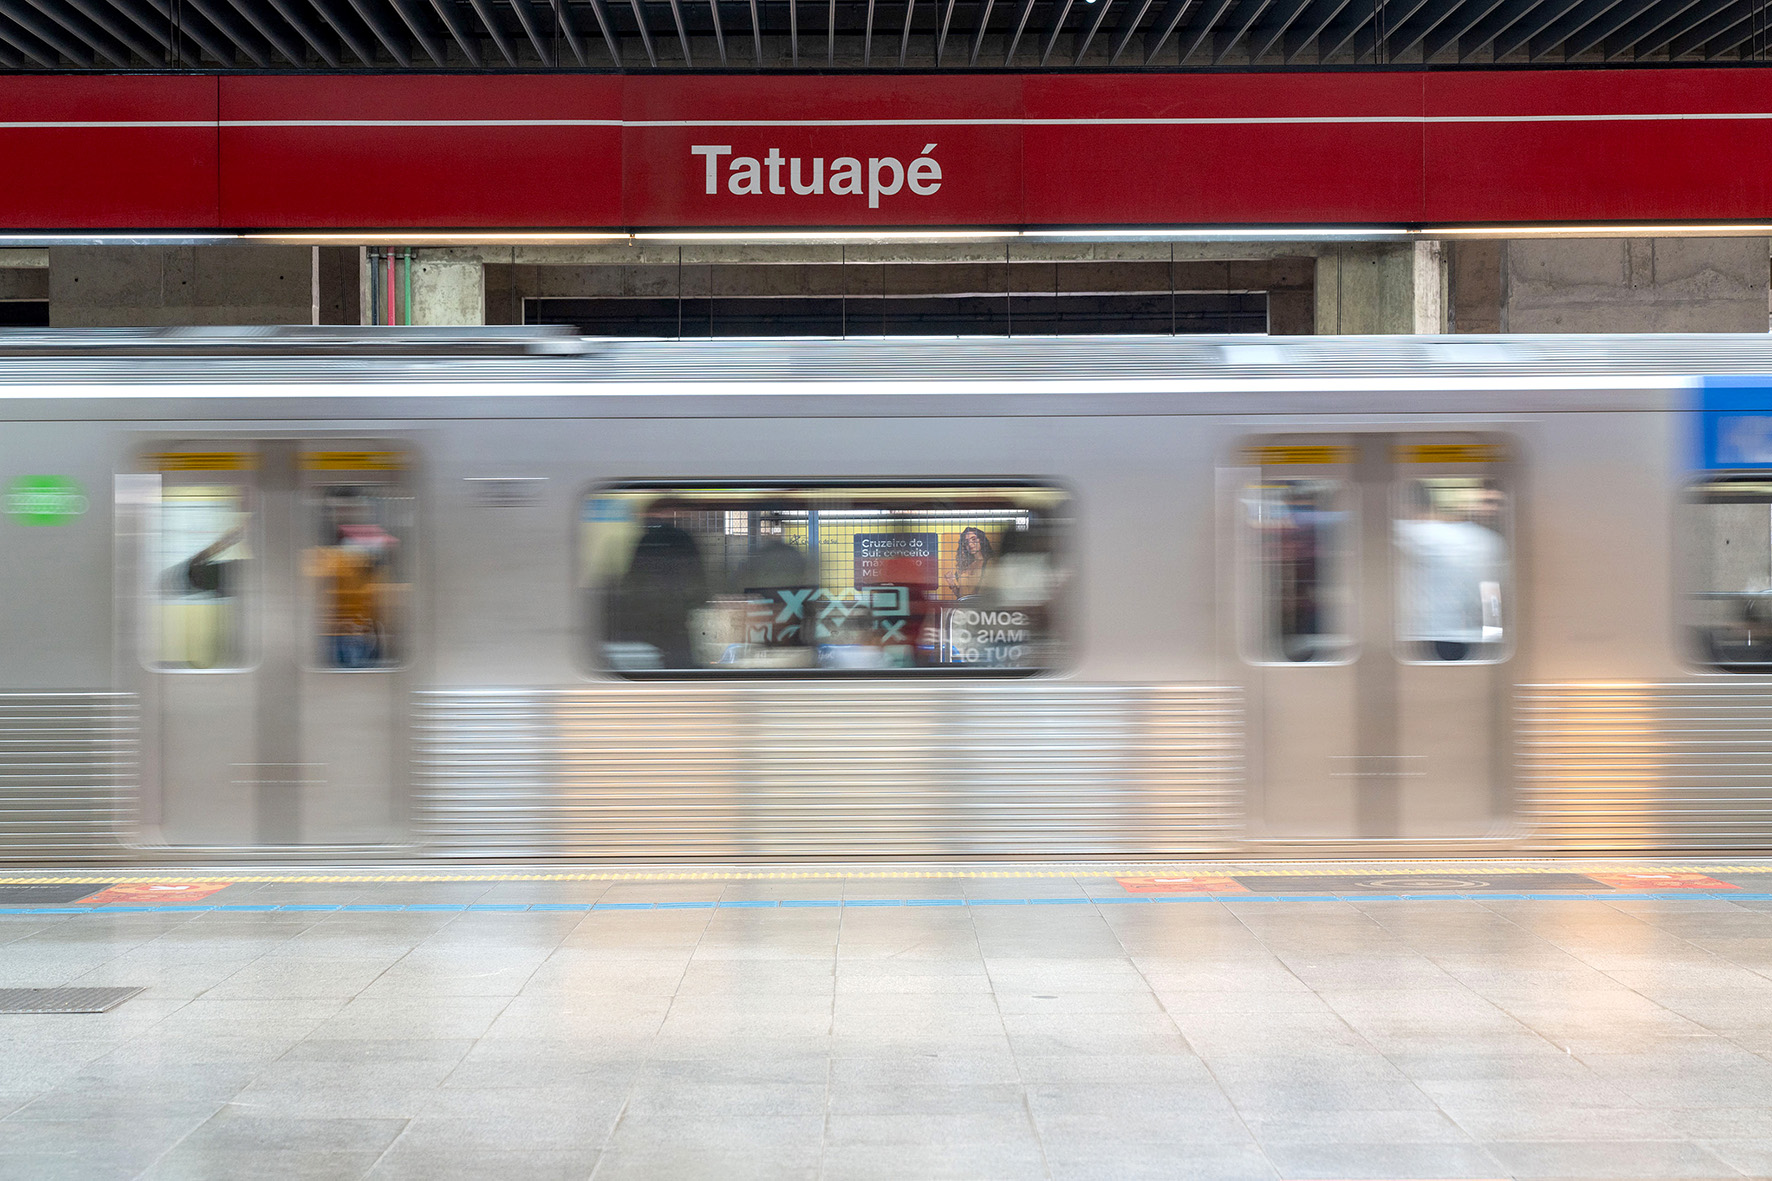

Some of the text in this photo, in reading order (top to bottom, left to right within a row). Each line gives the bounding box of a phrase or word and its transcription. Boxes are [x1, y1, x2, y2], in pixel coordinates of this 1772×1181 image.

[691, 143, 943, 209] Tatuapé
[861, 538, 923, 548] Cruzeiro do
[883, 548, 930, 557] conceito
